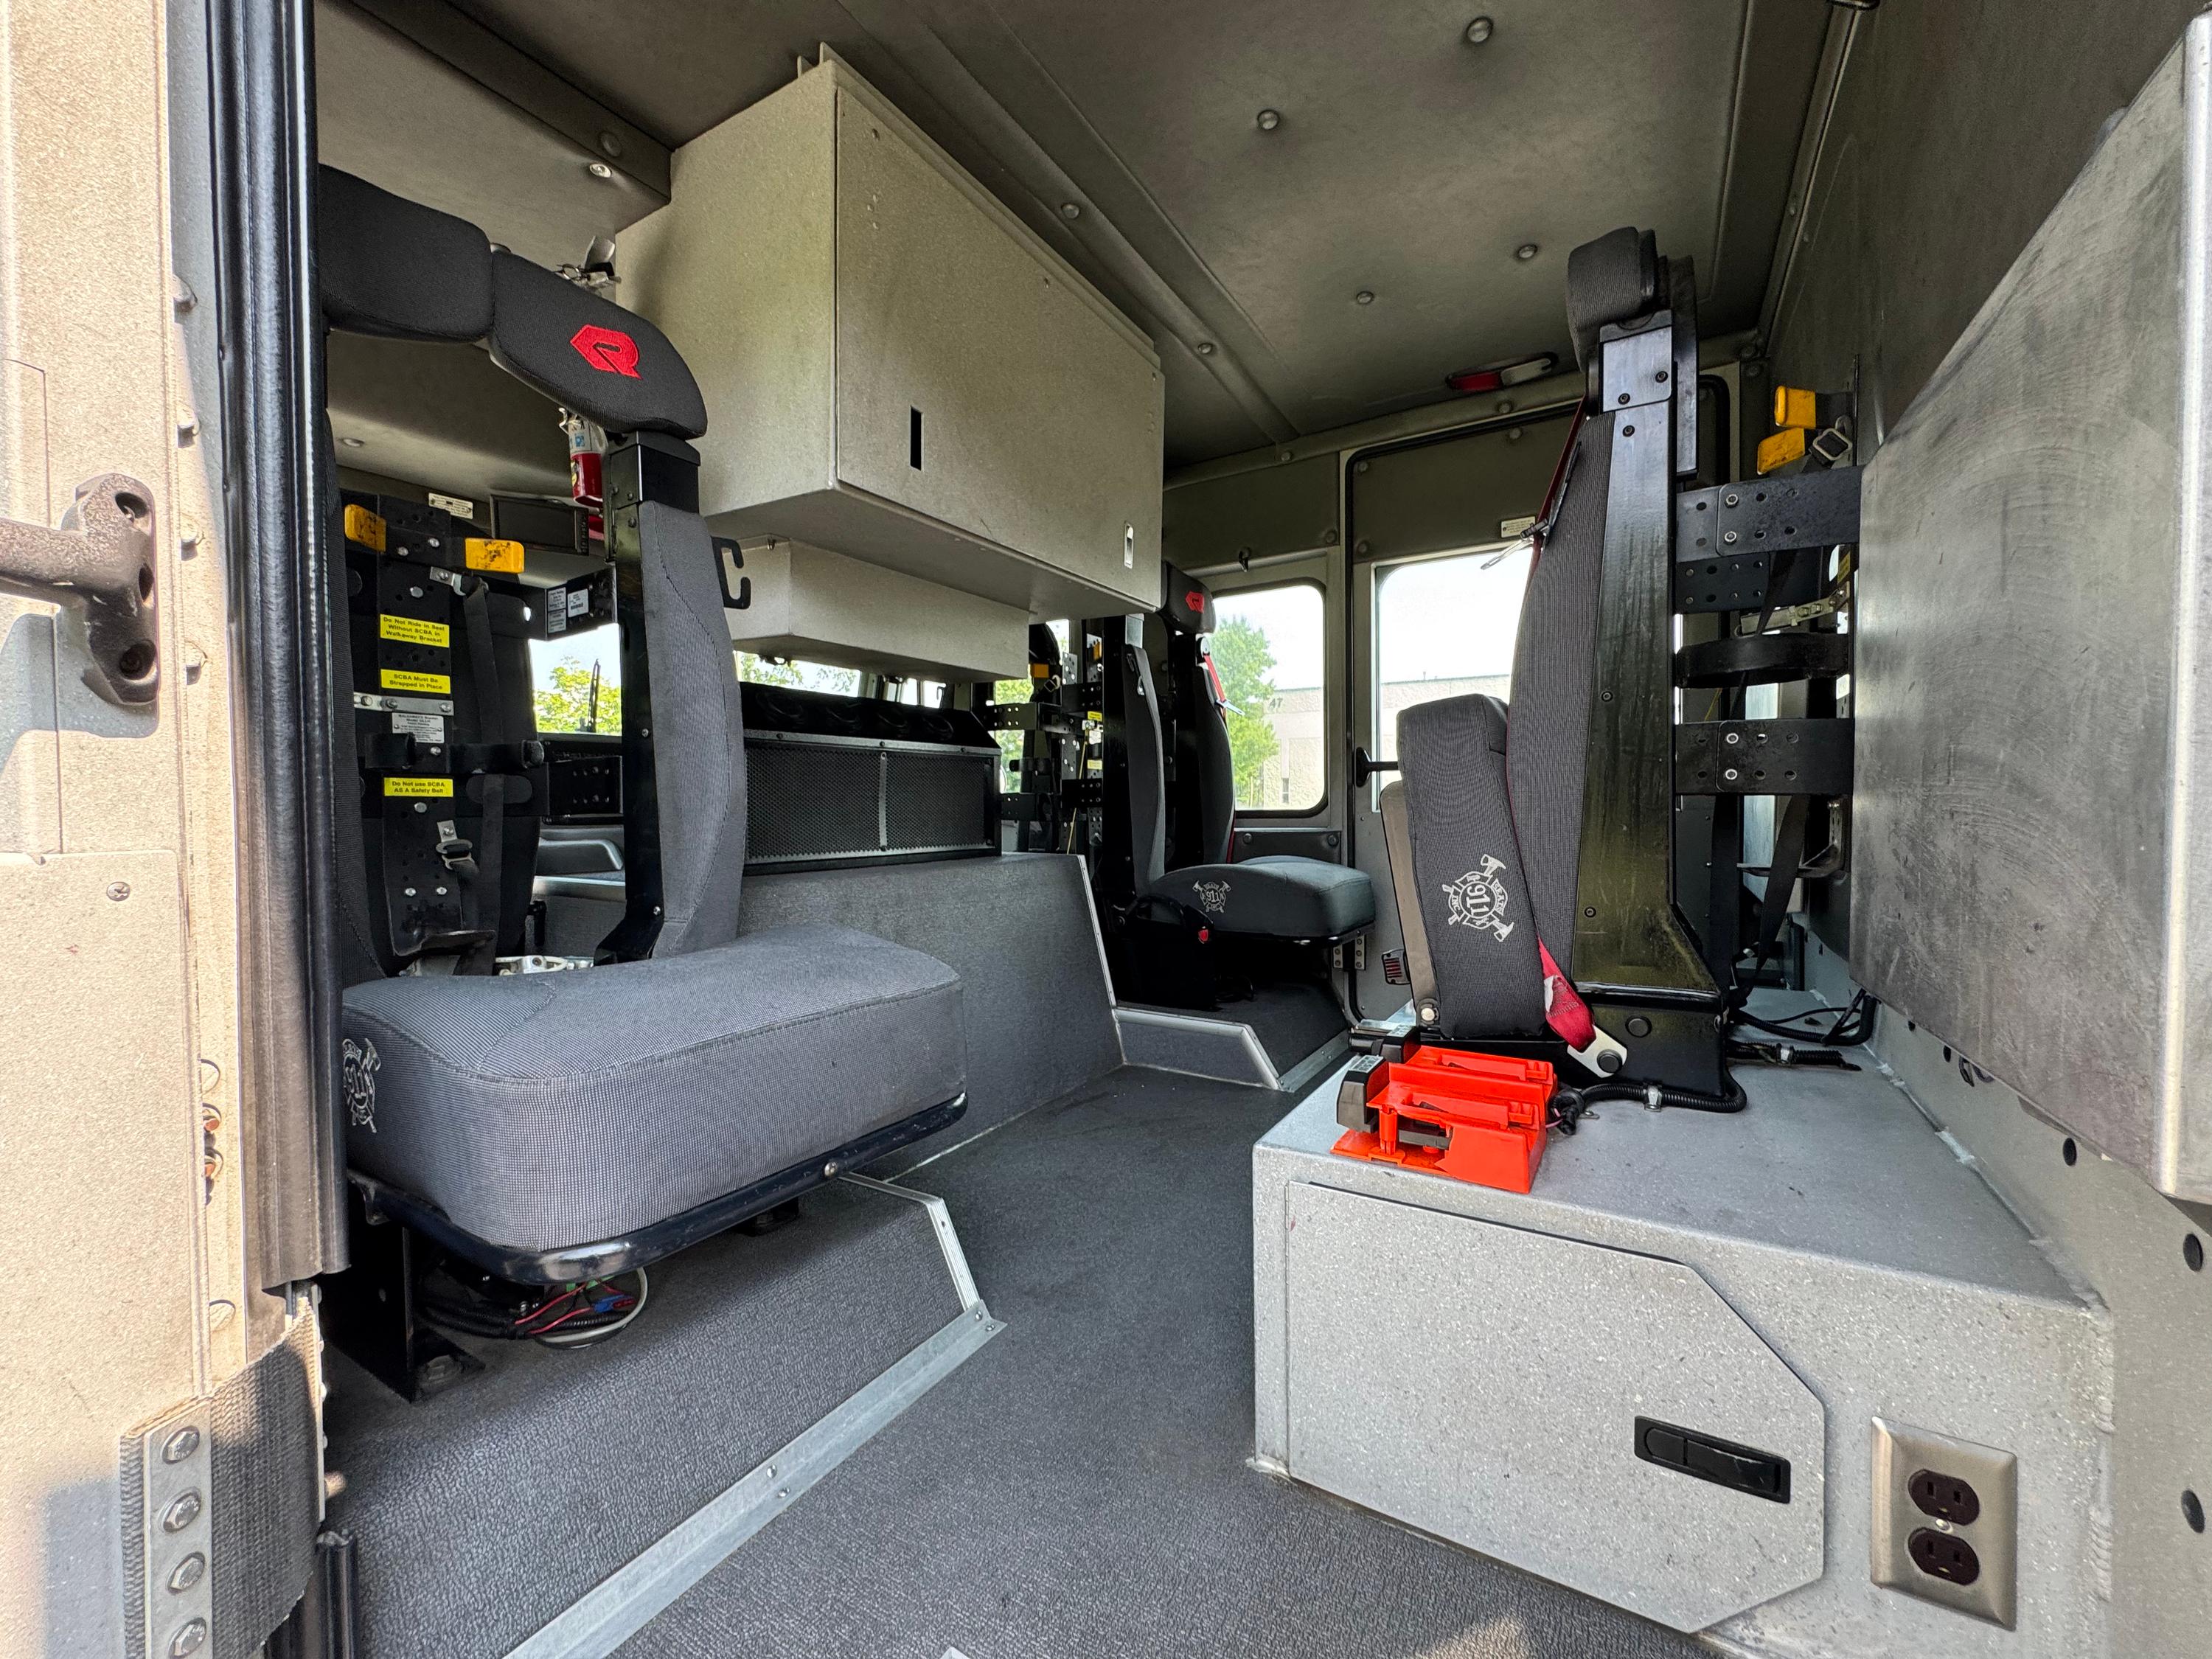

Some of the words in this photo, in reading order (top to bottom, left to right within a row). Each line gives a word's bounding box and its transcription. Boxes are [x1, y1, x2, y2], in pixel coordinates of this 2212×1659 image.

[389, 624, 412, 633] Without
[414, 627, 432, 636] SCBA
[386, 630, 417, 640] Walkaway
[420, 635, 442, 644] Bracket
[389, 679, 417, 687] Strapped
[1206, 890, 1220, 902] 911
[1451, 894, 1461, 911] INC
[1467, 884, 1490, 917] 911
